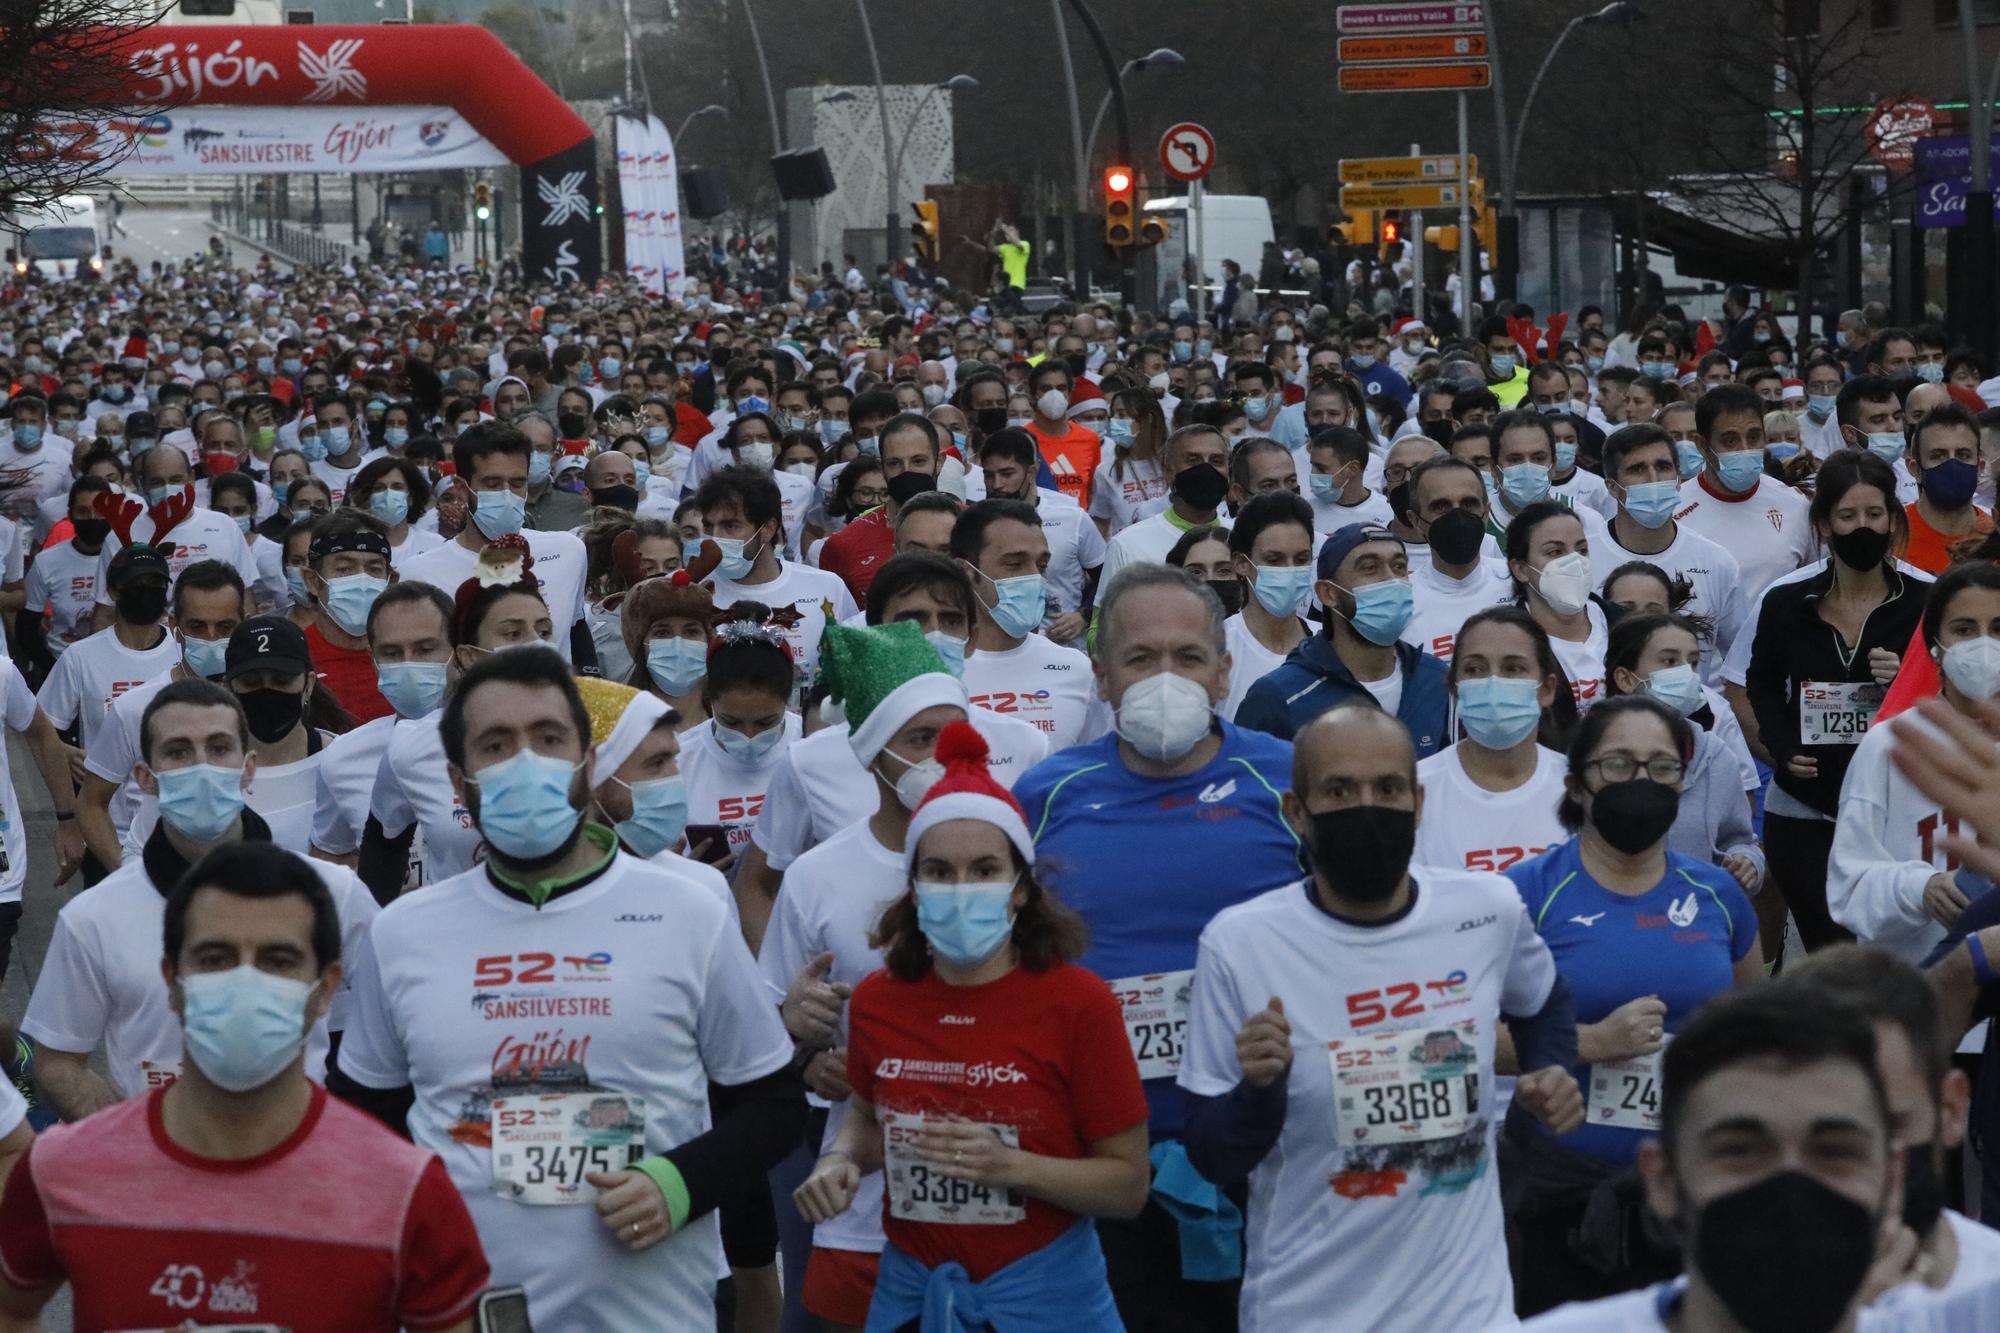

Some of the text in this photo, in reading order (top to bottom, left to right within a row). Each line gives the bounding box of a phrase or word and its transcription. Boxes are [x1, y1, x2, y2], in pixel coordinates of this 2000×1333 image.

[129, 39, 280, 101] gijón
[200, 144, 314, 164] SANSILVESTRE
[324, 119, 396, 164] Gijón
[257, 634, 269, 652] 2
[1432, 635, 1455, 657] 5
[1804, 689, 1826, 700] 52
[1822, 711, 1869, 733] 1236
[473, 952, 556, 987] 52
[484, 997, 613, 1021] SANSILVESTRE
[1345, 982, 1425, 1029] 52
[491, 1028, 593, 1082] Gijón
[1336, 1049, 1373, 1068] 52
[875, 1058, 903, 1079] 43
[966, 1060, 1029, 1089] gijón
[1363, 1079, 1451, 1125] 3368
[1620, 1076, 1658, 1111] 24
[499, 1109, 536, 1127] 52
[525, 1145, 609, 1185] 3475
[910, 1165, 991, 1206] 3364
[149, 1263, 205, 1309] 40
